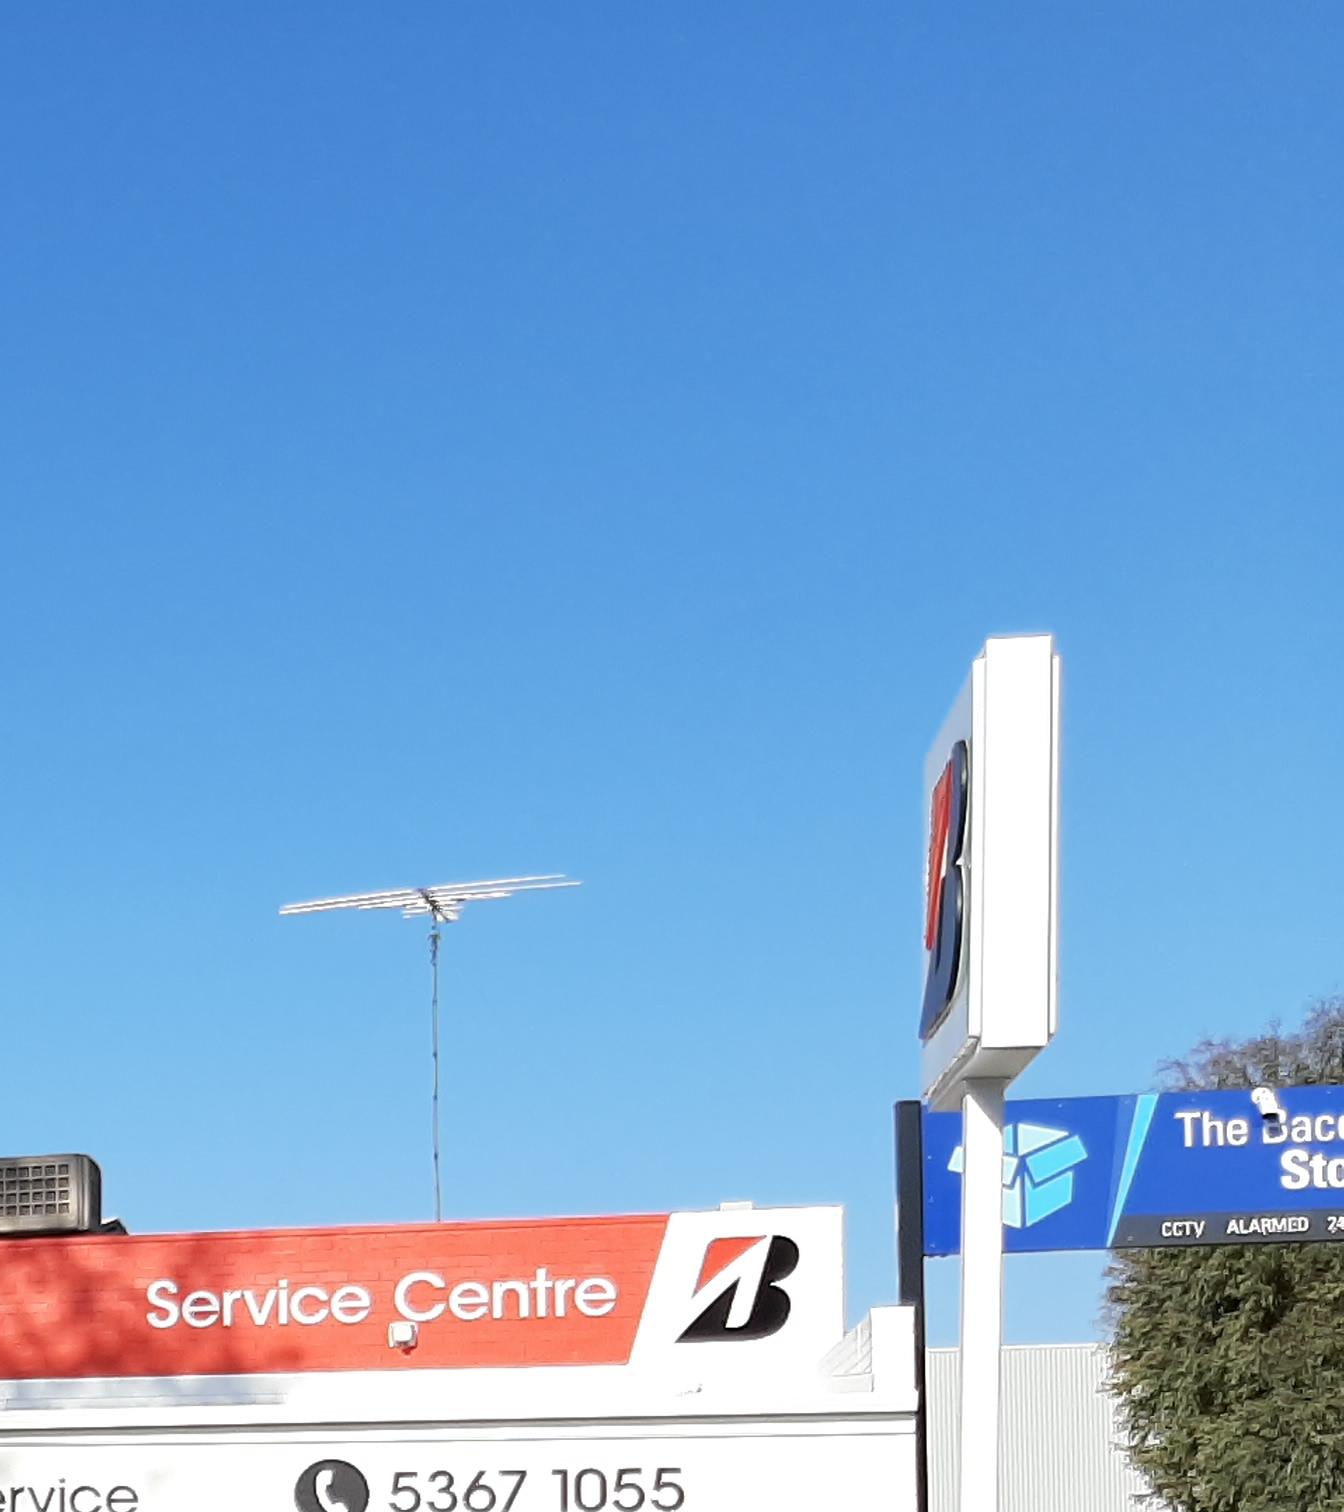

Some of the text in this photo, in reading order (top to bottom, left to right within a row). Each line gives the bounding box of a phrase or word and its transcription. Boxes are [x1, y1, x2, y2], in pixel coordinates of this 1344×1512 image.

[1174, 1111, 1248, 1147] The
[1162, 1219, 1206, 1239] CCTV
[1226, 1215, 1310, 1236] ALARMED
[146, 1267, 617, 1329] Service Centre
[552, 1467, 685, 1512] 1055
